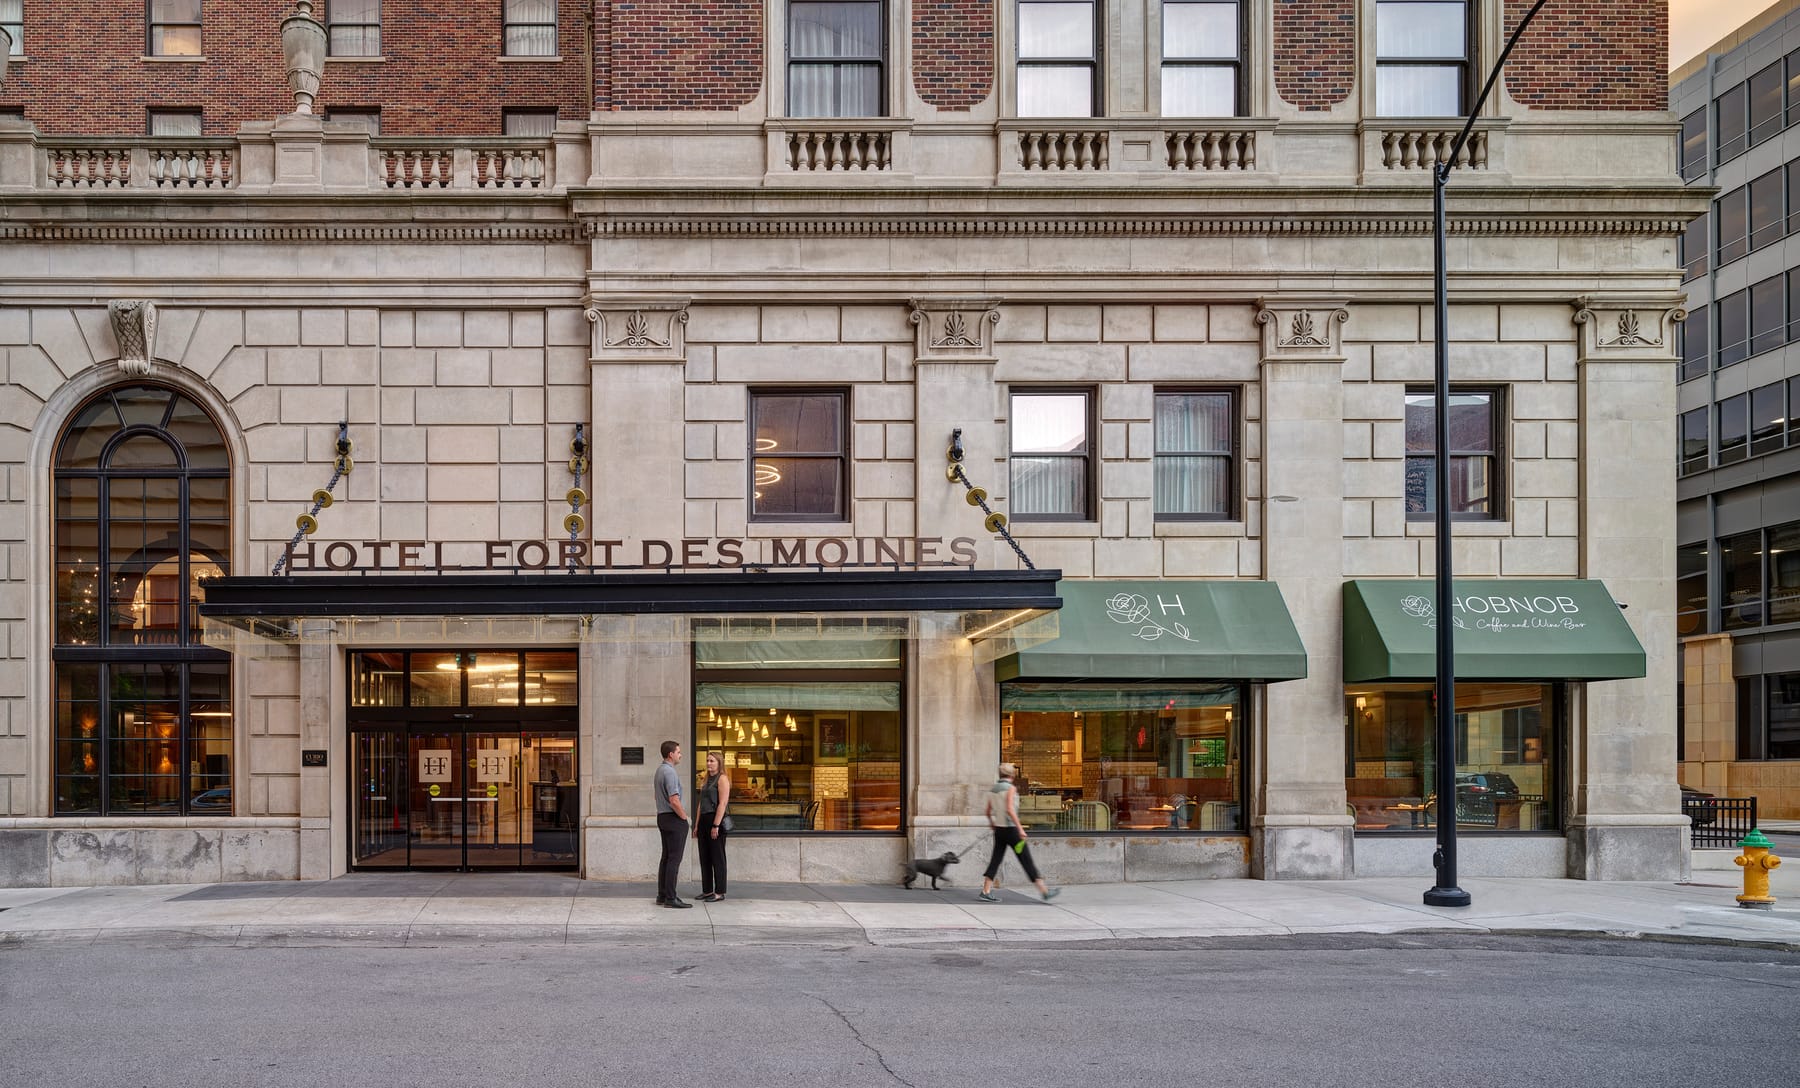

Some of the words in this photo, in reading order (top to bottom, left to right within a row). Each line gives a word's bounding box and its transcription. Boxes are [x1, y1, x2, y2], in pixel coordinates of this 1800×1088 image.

[285, 540, 461, 571] HOTEL
[486, 539, 623, 571] FORT
[641, 538, 744, 568] DES
[772, 537, 978, 568] MOINES
[1157, 594, 1186, 616] H
[1476, 617, 1510, 632] Coffee
[1512, 618, 1530, 628] and
[1531, 617, 1560, 628] Wine
[1560, 617, 1586, 630] Bar
